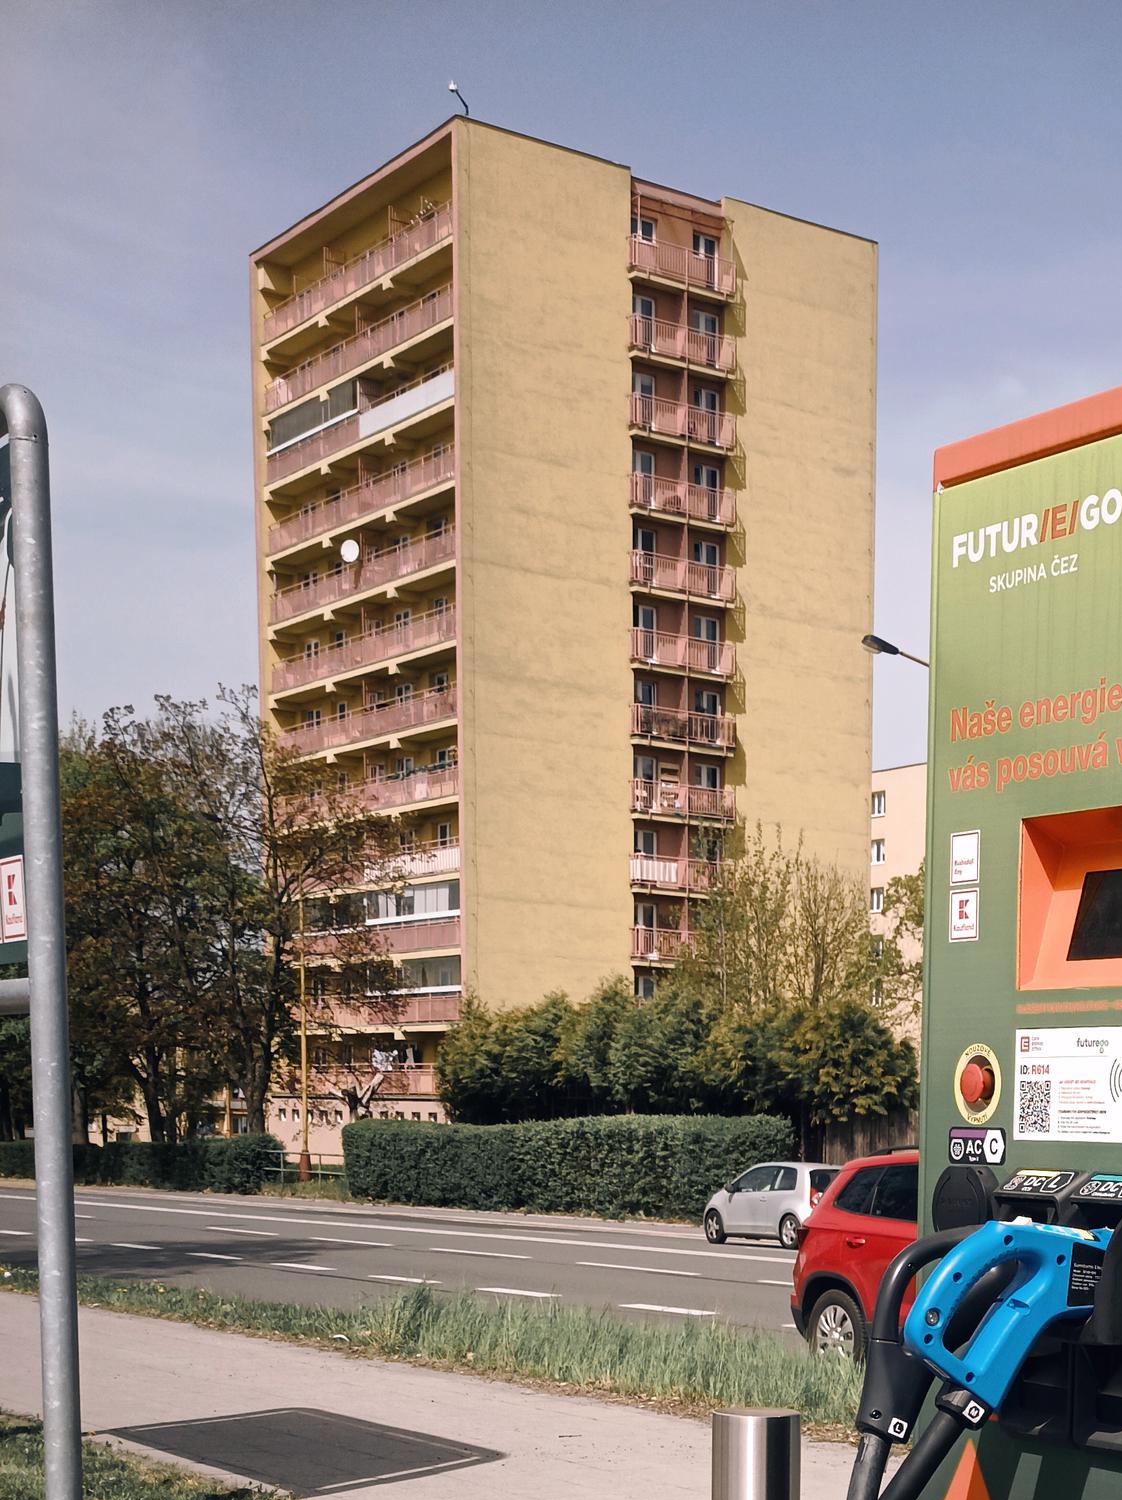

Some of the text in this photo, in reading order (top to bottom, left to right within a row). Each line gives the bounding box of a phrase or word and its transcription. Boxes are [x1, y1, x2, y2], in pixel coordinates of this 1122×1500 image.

[989, 553, 1079, 593] SKUPINA ČEZ
[950, 700, 1012, 742] Naše
[948, 755, 989, 793] vás
[996, 732, 1108, 793] posouvá
[1020, 1064, 1050, 1075] ID: R614
[965, 1139, 982, 1155] AC
[990, 1138, 998, 1155] C
[1023, 1176, 1046, 1186] DC
[1048, 1176, 1061, 1188] L
[1098, 1181, 1122, 1192] DC
